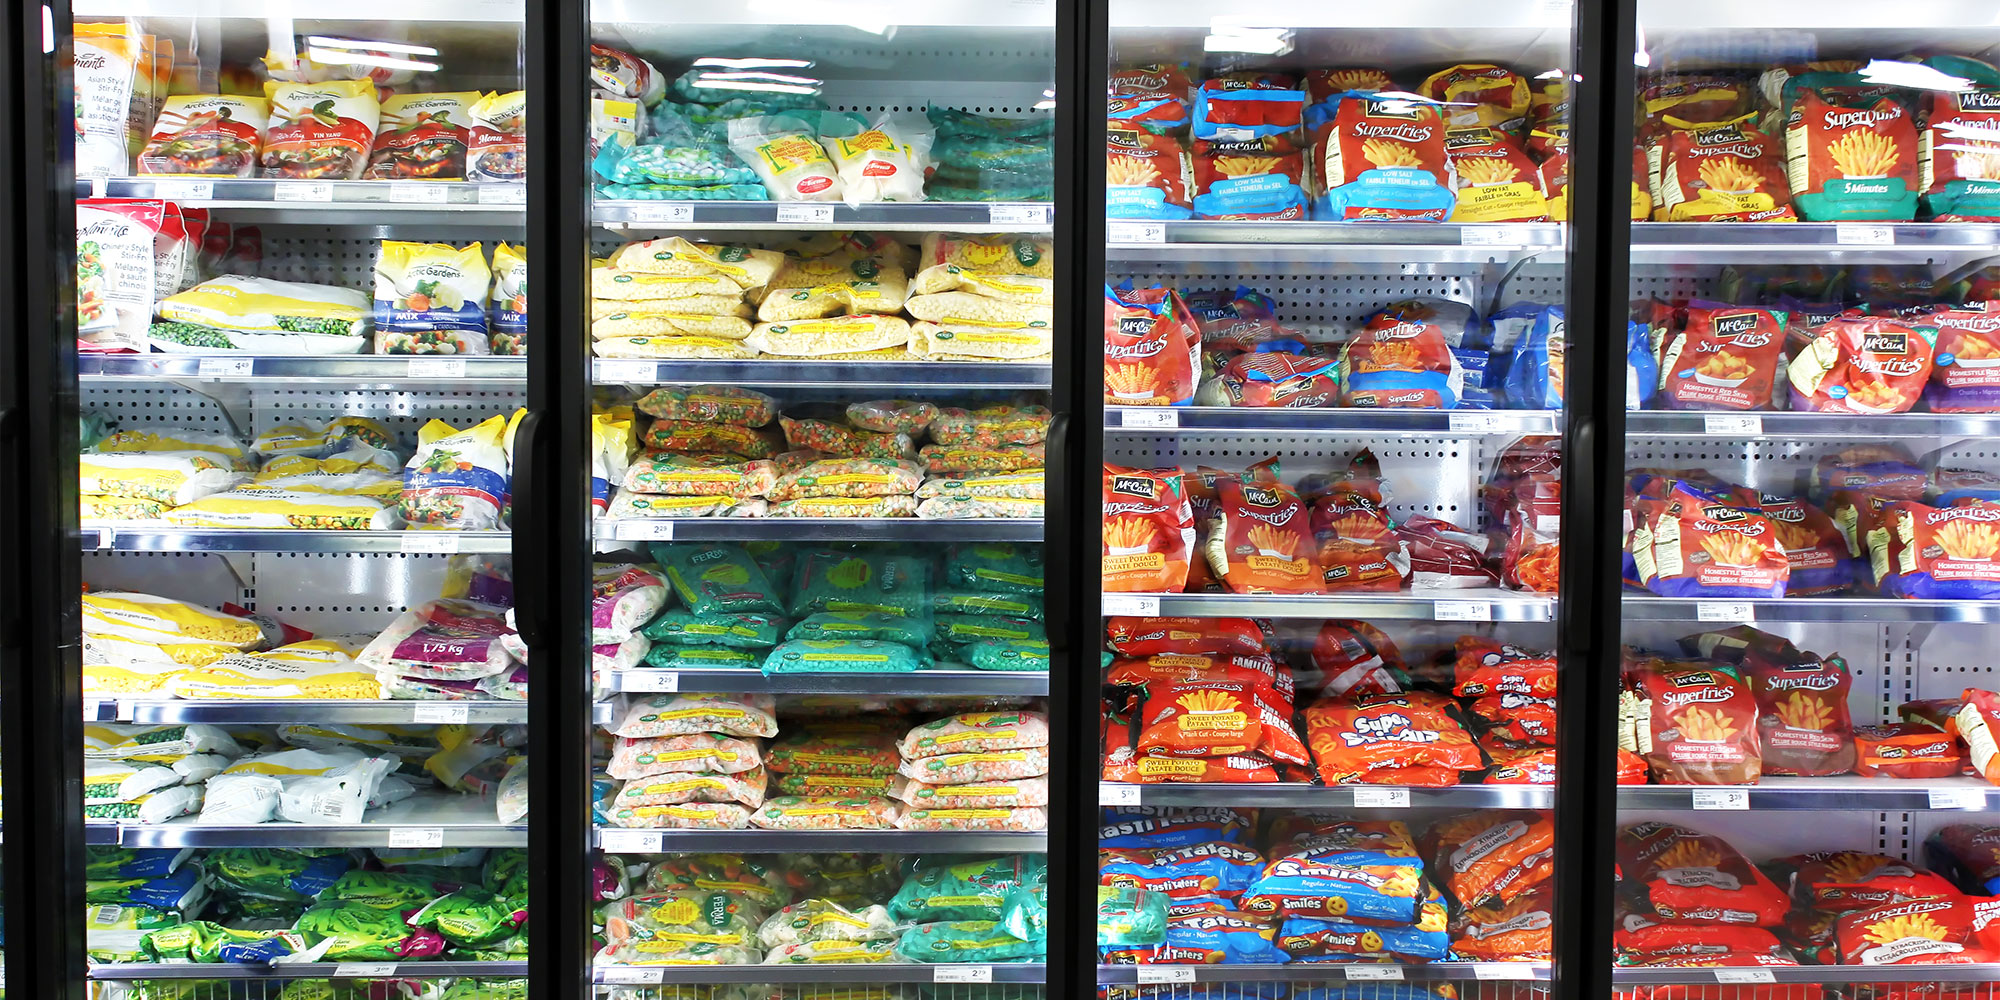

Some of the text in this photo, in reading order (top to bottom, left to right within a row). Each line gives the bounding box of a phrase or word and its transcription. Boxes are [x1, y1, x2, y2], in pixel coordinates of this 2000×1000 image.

[401, 102, 424, 110] Arctic
[1352, 122, 1433, 142] Superfries
[479, 135, 502, 144] Menu
[1698, 133, 1746, 144] McCain
[1689, 144, 1763, 159] Superfries
[1844, 183, 1888, 193] 5 Minutes
[1964, 184, 1972, 194] 5
[1475, 194, 1495, 203] FAIBLE
[131, 244, 149, 253] Style
[121, 251, 148, 262] Stir-Fry
[426, 268, 460, 278] Gardens
[1934, 315, 2000, 333] Superfries
[1864, 338, 1904, 351] McCain
[1848, 354, 1924, 376] Superfries
[1683, 384, 1718, 393] HOMESTYLE
[1388, 392, 1424, 404] Superfries
[1115, 479, 1153, 496] McCain
[1247, 492, 1280, 505] McCain
[1238, 502, 1298, 527] Superfries
[1707, 509, 1743, 519] McCain
[1104, 560, 1157, 571] PATATE DOUCE
[1255, 561, 1281, 569] PATATE
[423, 643, 464, 655] 1.75 kg
[658, 676, 672, 685] 229
[1501, 675, 1524, 684] Super
[1677, 675, 1712, 685] McCain
[1766, 673, 1840, 692] Superfries
[1662, 686, 1735, 705] Superfries
[1354, 712, 1411, 734] Super
[1771, 738, 1790, 746] PELURE
[1911, 741, 1949, 756] Superfries
[1729, 793, 1742, 802] 339
[1177, 844, 1258, 862] Taters
[1301, 880, 1326, 888] Regular
[1282, 898, 1321, 909] Smiles
[711, 896, 724, 925] FERMA
[1850, 901, 1952, 928] Superfries
[1172, 952, 1203, 960] Taters
